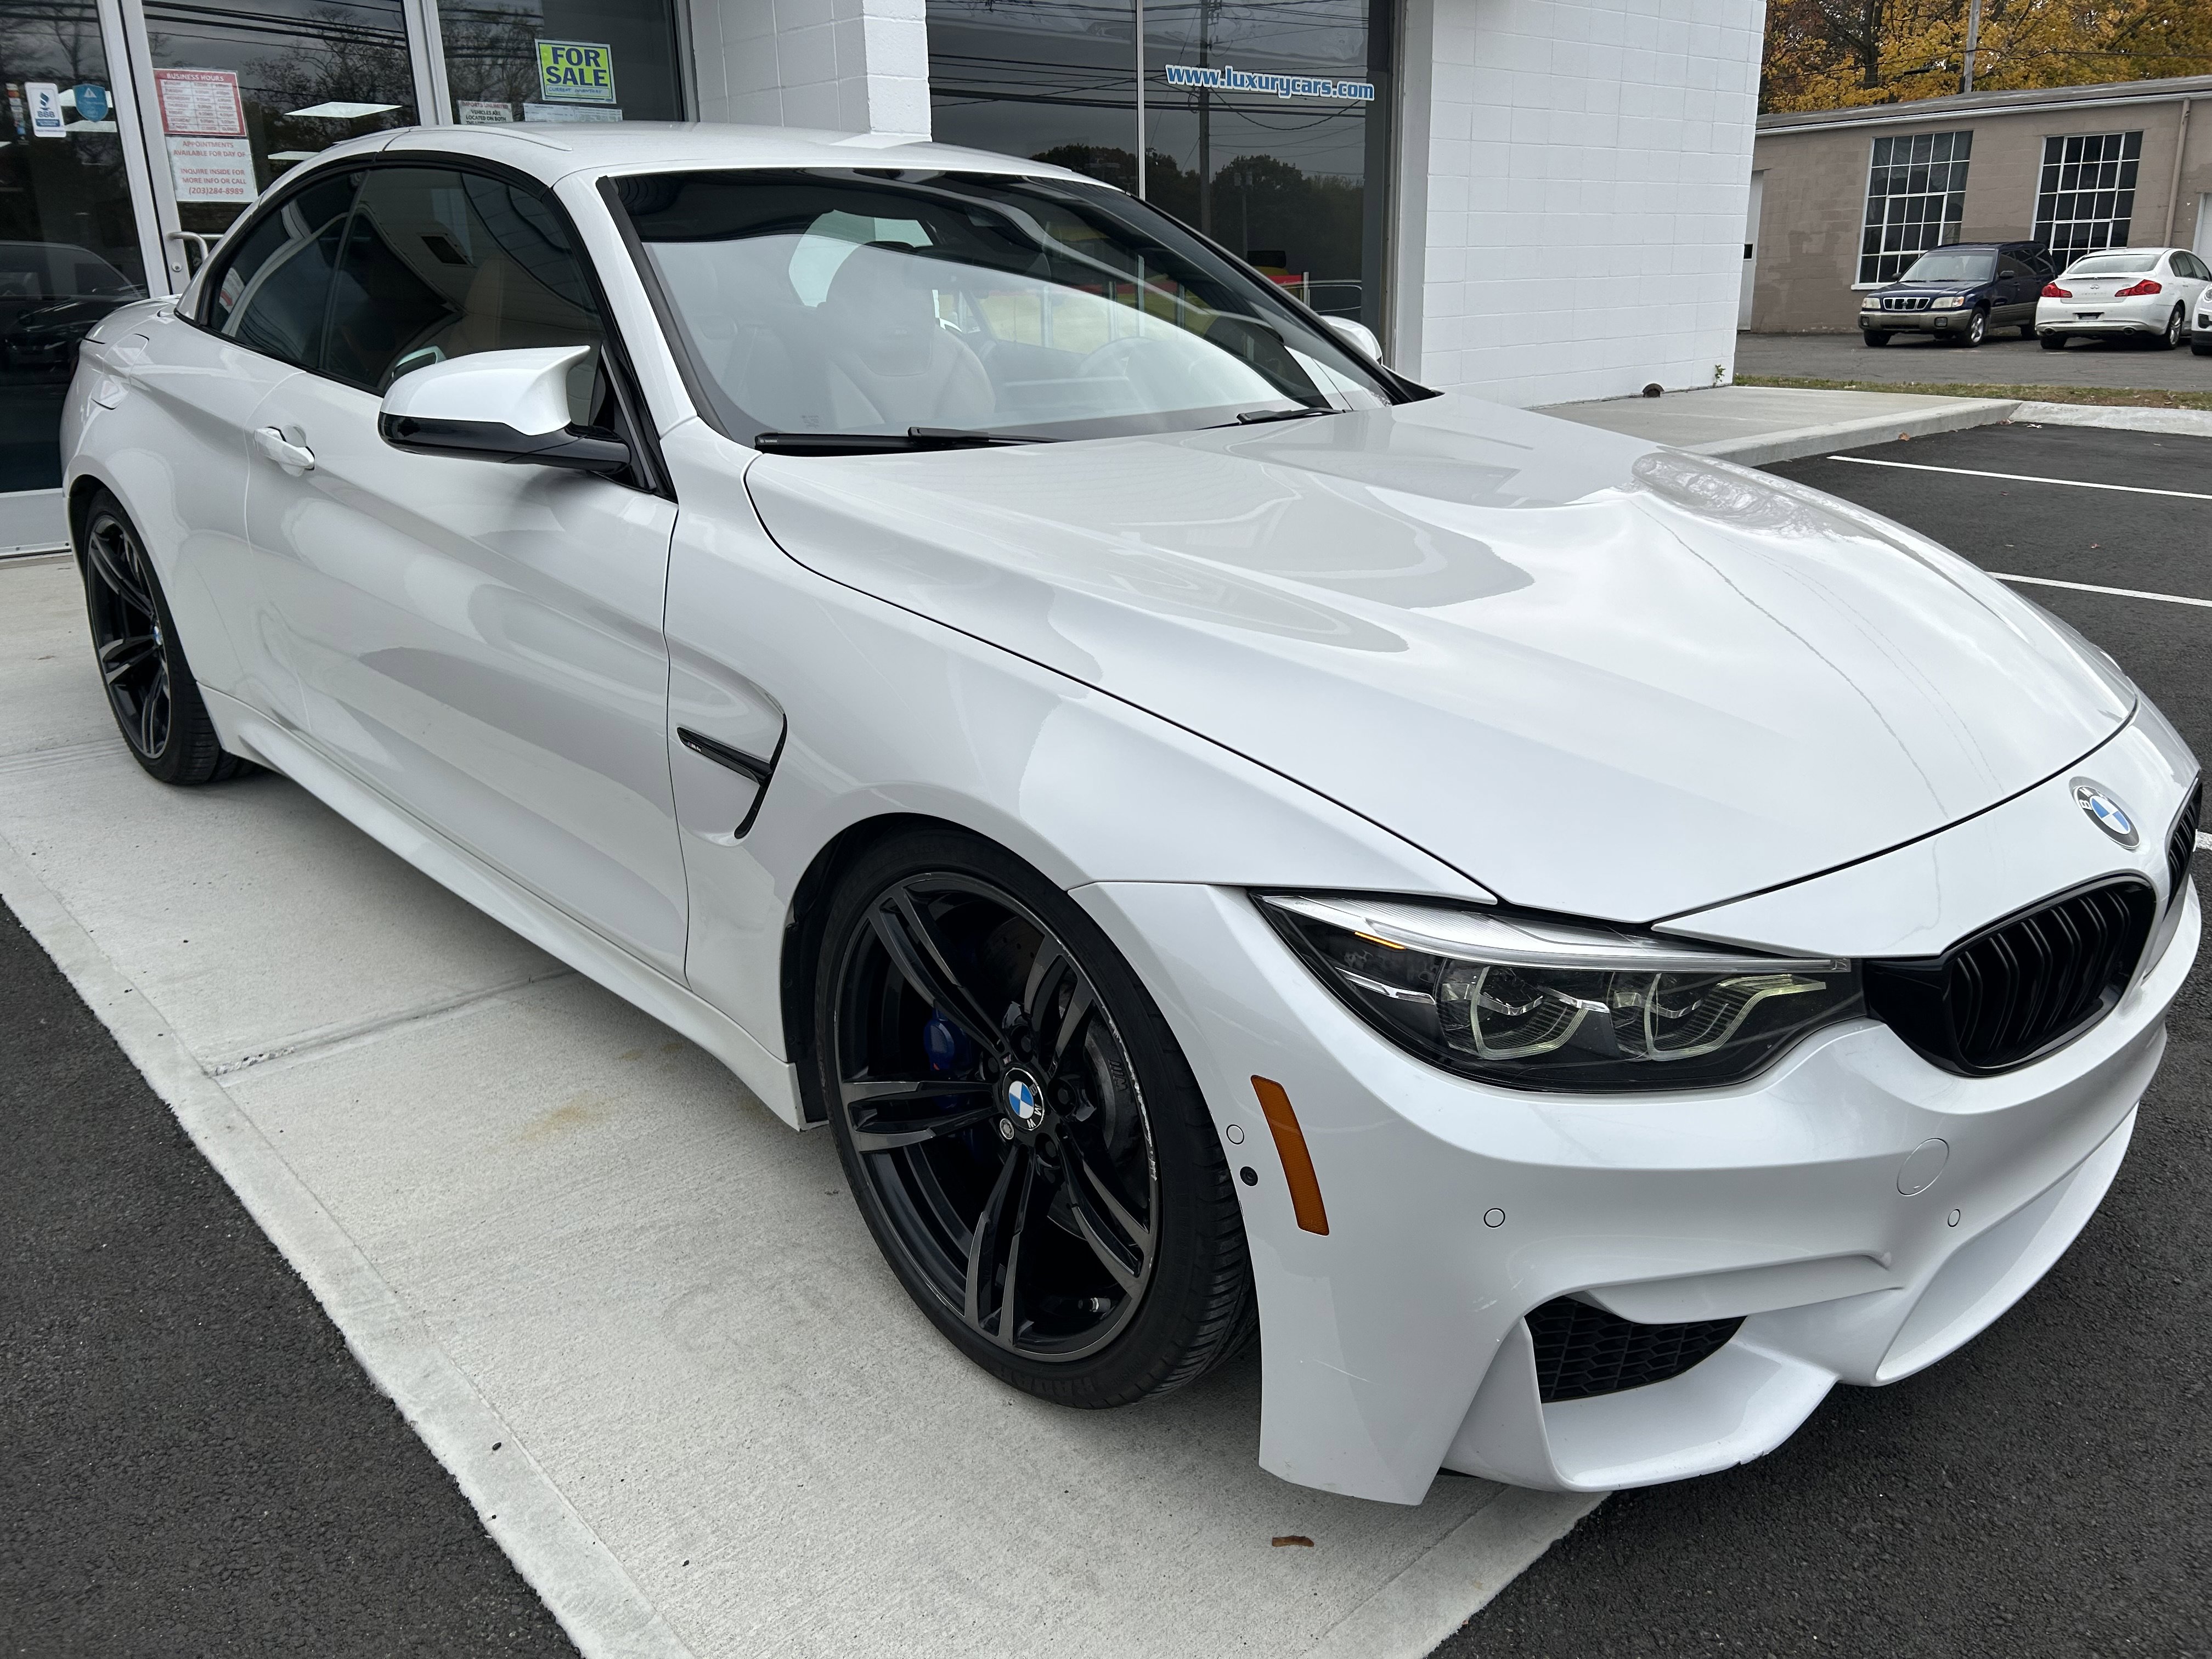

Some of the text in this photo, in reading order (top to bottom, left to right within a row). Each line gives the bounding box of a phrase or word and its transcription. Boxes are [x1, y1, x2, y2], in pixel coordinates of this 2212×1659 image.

[551, 47, 601, 67] FOR
[546, 66, 608, 87] SALE
[1165, 65, 1374, 100] www.luxurycars.com
[1026, 1083, 1042, 1128] BMW
